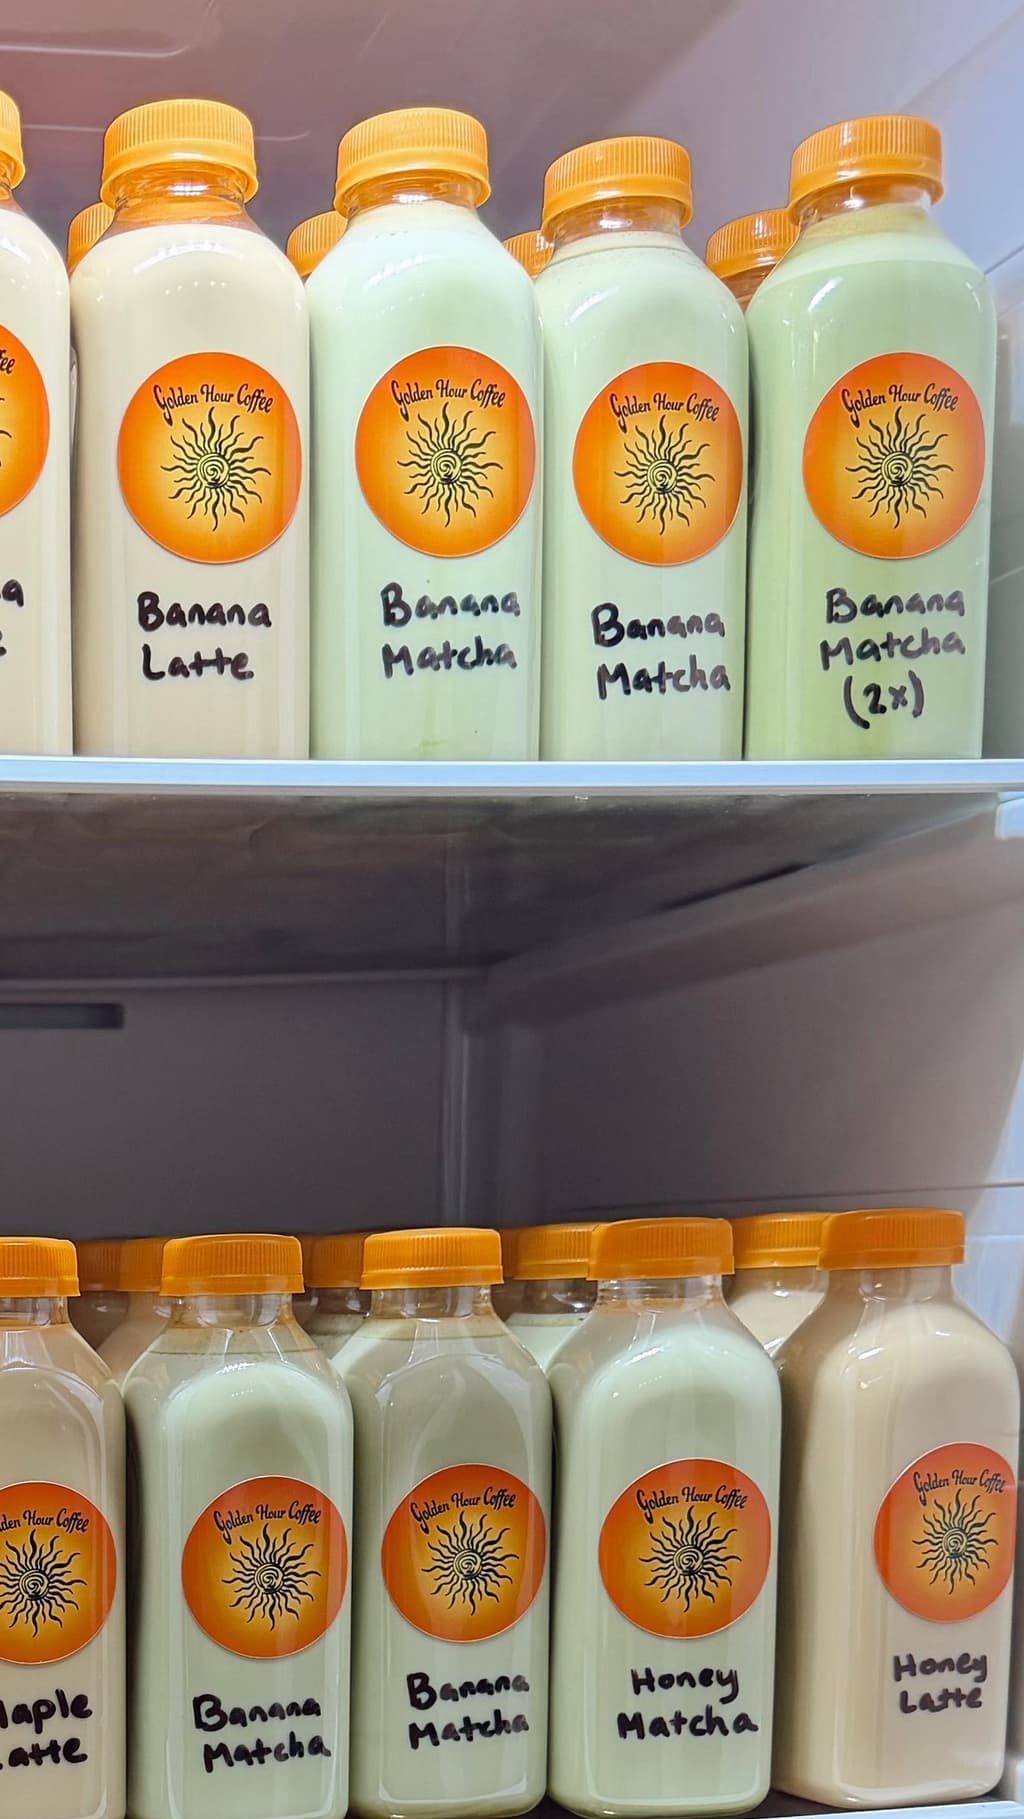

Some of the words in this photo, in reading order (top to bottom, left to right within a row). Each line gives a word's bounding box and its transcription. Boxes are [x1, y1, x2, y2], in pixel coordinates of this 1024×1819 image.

[153, 384, 198, 425] Golden
[200, 384, 234, 402] Hour
[237, 384, 273, 413] Coffee
[391, 381, 433, 421] Golden
[435, 380, 467, 398] Hour
[470, 379, 505, 407] Coffee
[610, 393, 651, 432] Golden
[653, 393, 684, 411] Hour
[687, 393, 719, 422] Coffee
[842, 388, 886, 427] Golden
[888, 384, 920, 403] Hour
[924, 383, 958, 411] Coffee
[137, 591, 271, 631] Banana
[380, 582, 520, 627] Banana
[827, 587, 965, 624] Banana
[591, 602, 725, 648] Banana
[142, 644, 254, 680] Latte
[381, 636, 517, 678] Matcha
[821, 628, 966, 670] Matcha
[596, 654, 731, 700] Matcha
[23, 1510, 53, 1527] Hour
[56, 1508, 89, 1533] Coffee
[214, 1510, 254, 1544] Golden
[256, 1504, 285, 1521] Hour
[288, 1500, 321, 1525] Coffee
[411, 1503, 449, 1533] Golden
[451, 1492, 480, 1509] Hour
[483, 1487, 516, 1508] Coffee
[636, 1489, 679, 1523] Golden
[681, 1487, 712, 1503] Hour
[715, 1485, 747, 1510] Coffee
[631, 1667, 739, 1704] Honey
[893, 1653, 987, 1683] Honey
[407, 1671, 530, 1710] Banana
[900, 1688, 982, 1713] Latte
[192, 1693, 322, 1732] Banana
[409, 1709, 529, 1749] Matcha
[617, 1705, 758, 1740] Matcha
[204, 1732, 331, 1773] Matcha
